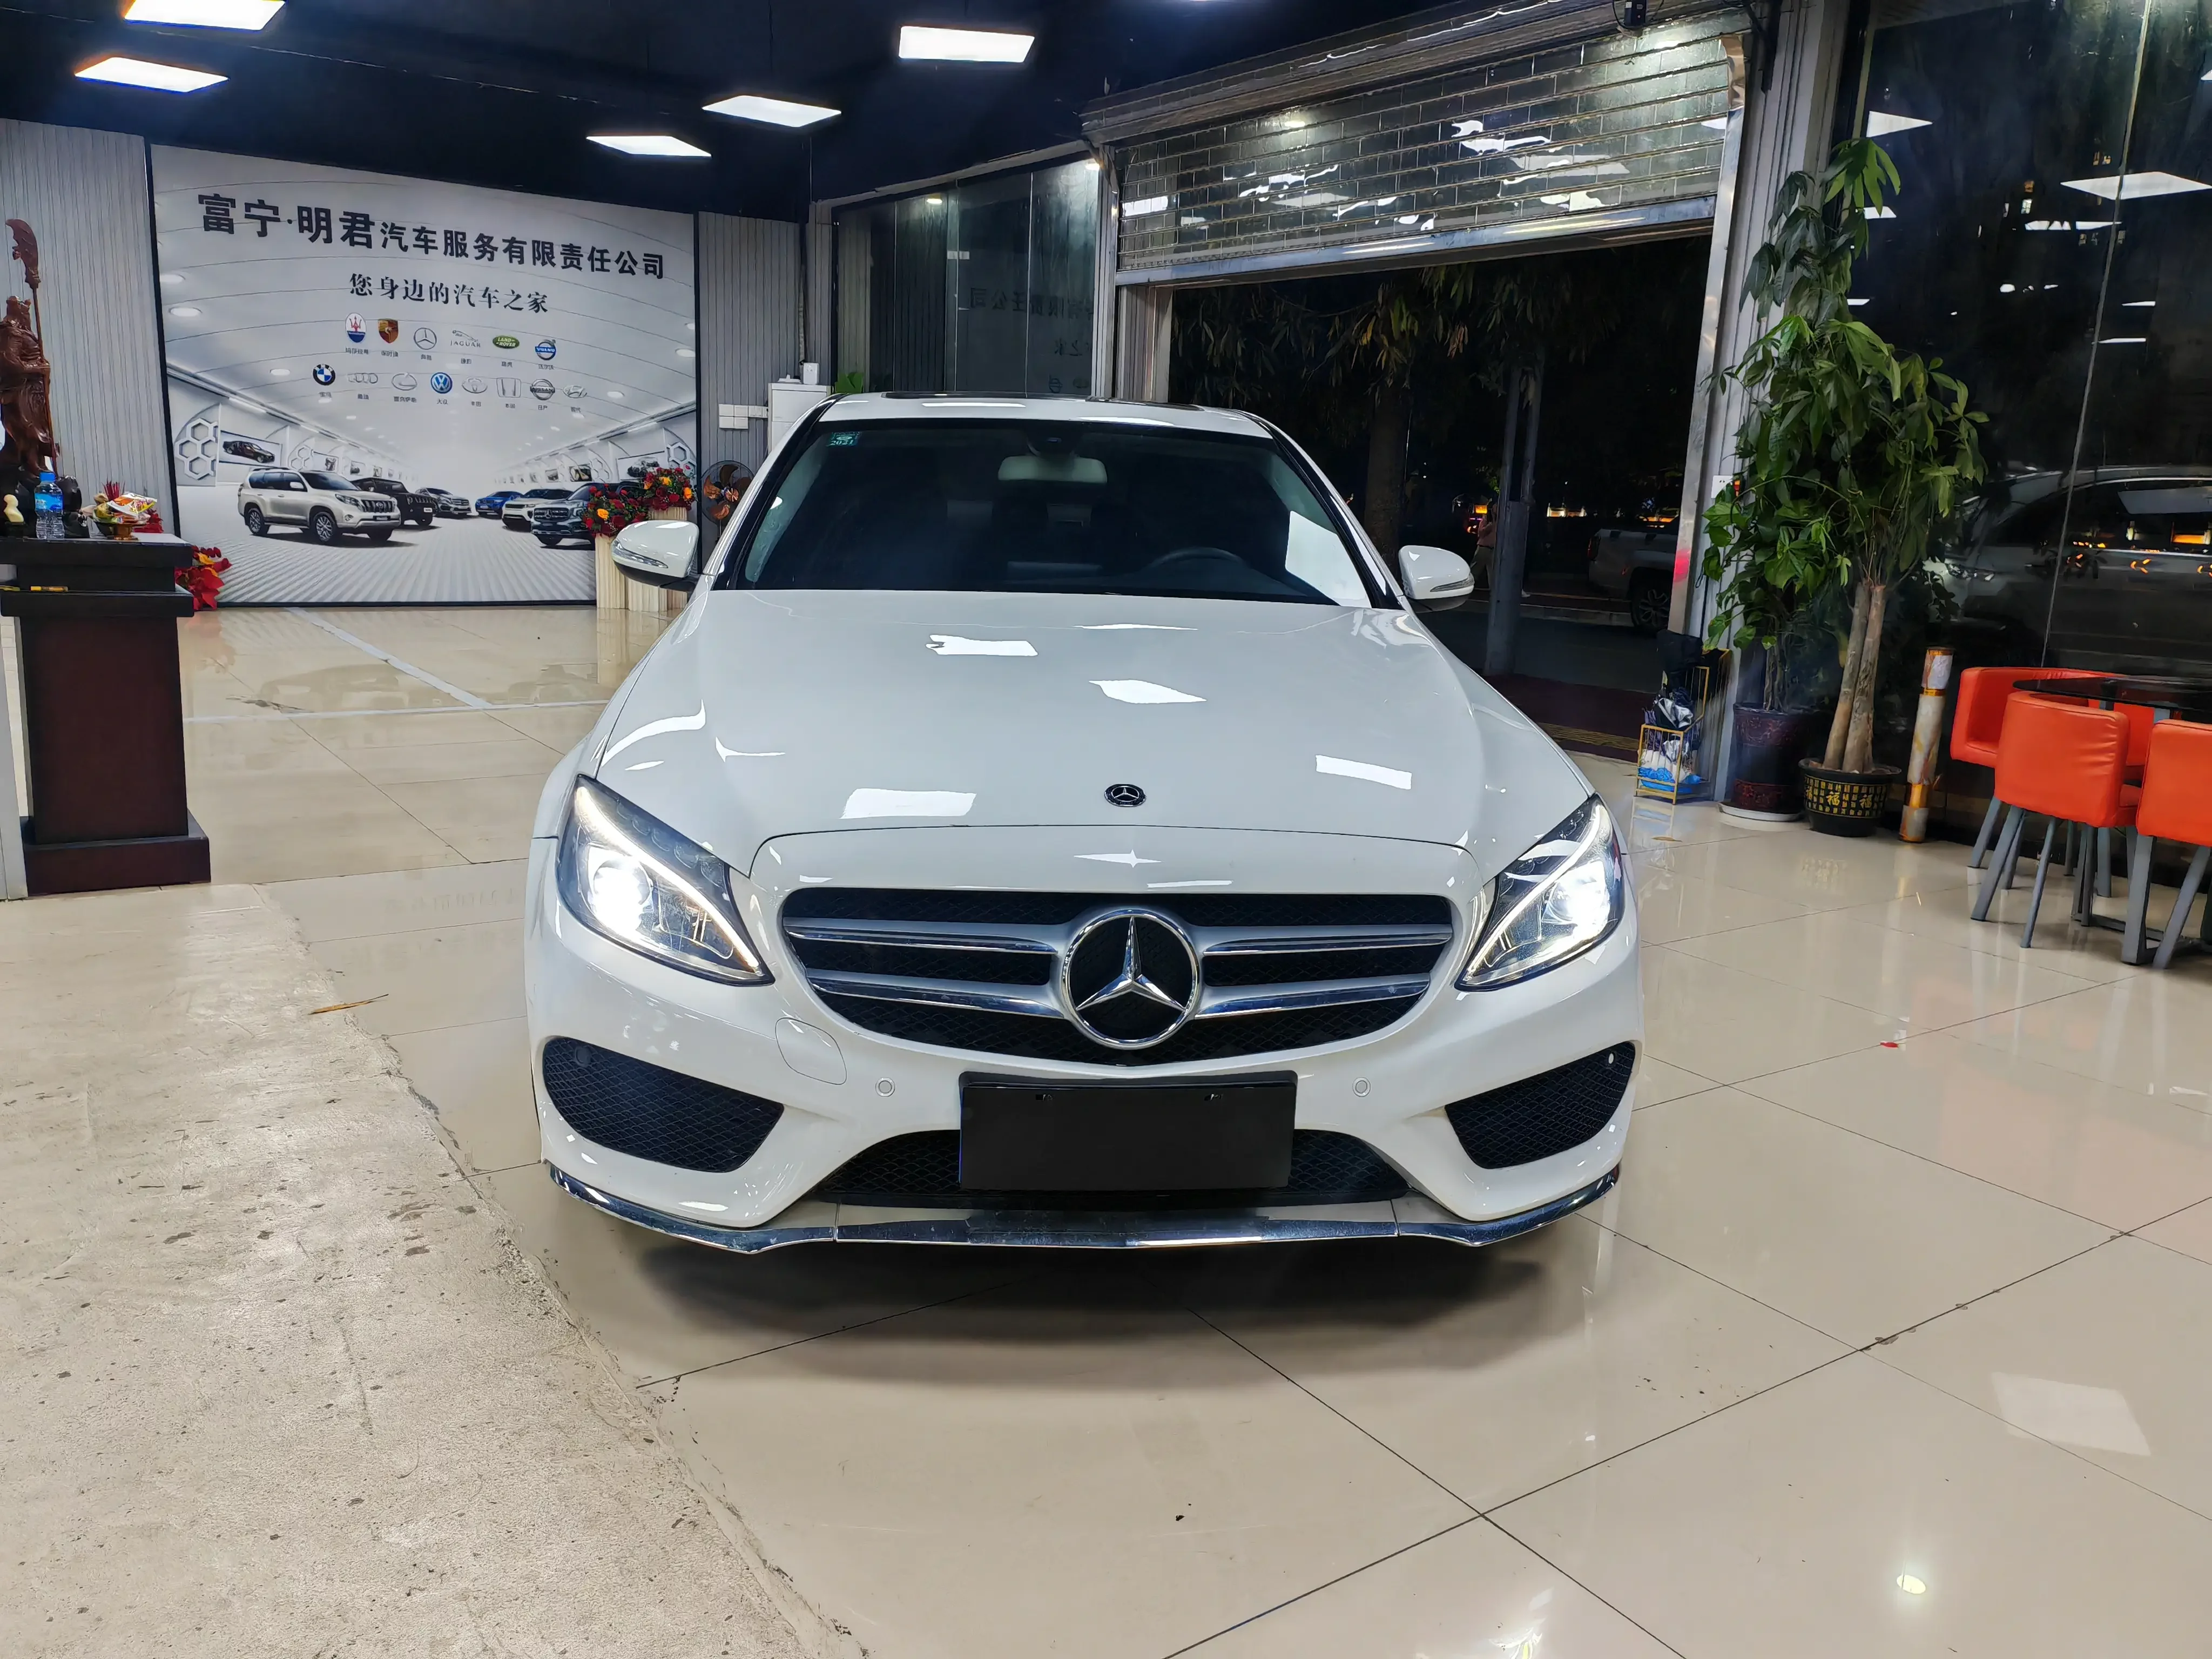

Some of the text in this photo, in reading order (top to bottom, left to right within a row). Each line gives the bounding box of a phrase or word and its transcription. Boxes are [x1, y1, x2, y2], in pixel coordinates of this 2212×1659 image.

[198, 193, 665, 280] 富宁·明君汽车服务有限责任公司
[349, 273, 549, 314] 您身边的汽车之家
